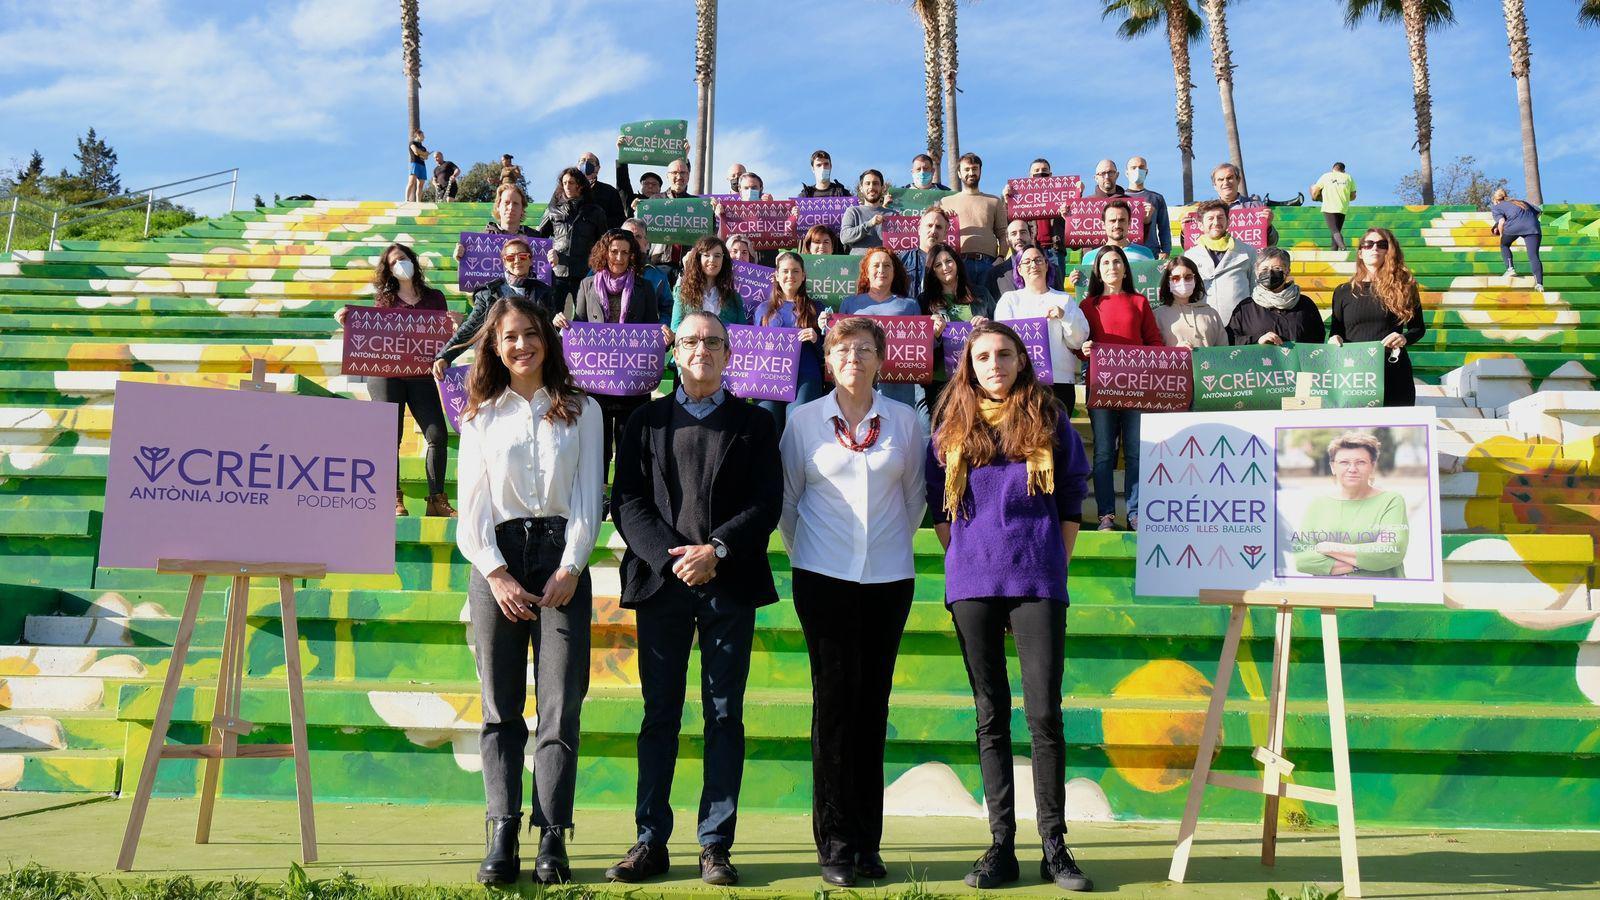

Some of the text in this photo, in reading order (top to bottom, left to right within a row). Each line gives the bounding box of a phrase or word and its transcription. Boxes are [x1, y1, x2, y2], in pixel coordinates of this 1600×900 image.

[634, 135, 683, 151] CRÉIXER
[1024, 189, 1076, 204] CRÉIXER
[655, 213, 708, 229] CRÉIXER
[738, 218, 793, 233] CRÉIXER
[806, 276, 856, 294] CRÉIXE
[381, 353, 401, 361] JOVER
[584, 349, 658, 370] CRÉIXER
[887, 344, 927, 361] IXER
[726, 351, 793, 374] RÉIXER
[627, 370, 657, 378] PODEMOS
[730, 371, 749, 379] JOVER
[760, 373, 791, 382] PODEMOS
[1114, 370, 1187, 392] CRÉIXER
[1219, 368, 1297, 390] CRÉIXER
[1312, 369, 1377, 389] RÉIXER
[1096, 389, 1186, 400] ANTÒNIA JOVER PODEMOS
[1201, 391, 1232, 400] ANTÒNIA
[1343, 389, 1377, 397] PODEMOS
[178, 443, 376, 494] CRÉIXER
[130, 486, 376, 511] ANTÒNIA JOVER PODEMOS
[1145, 494, 1267, 523] CRÉIXER
[1145, 524, 1262, 534] PODEMOS ILLES BALEARS
[1291, 528, 1352, 543] ANTÒNIA
